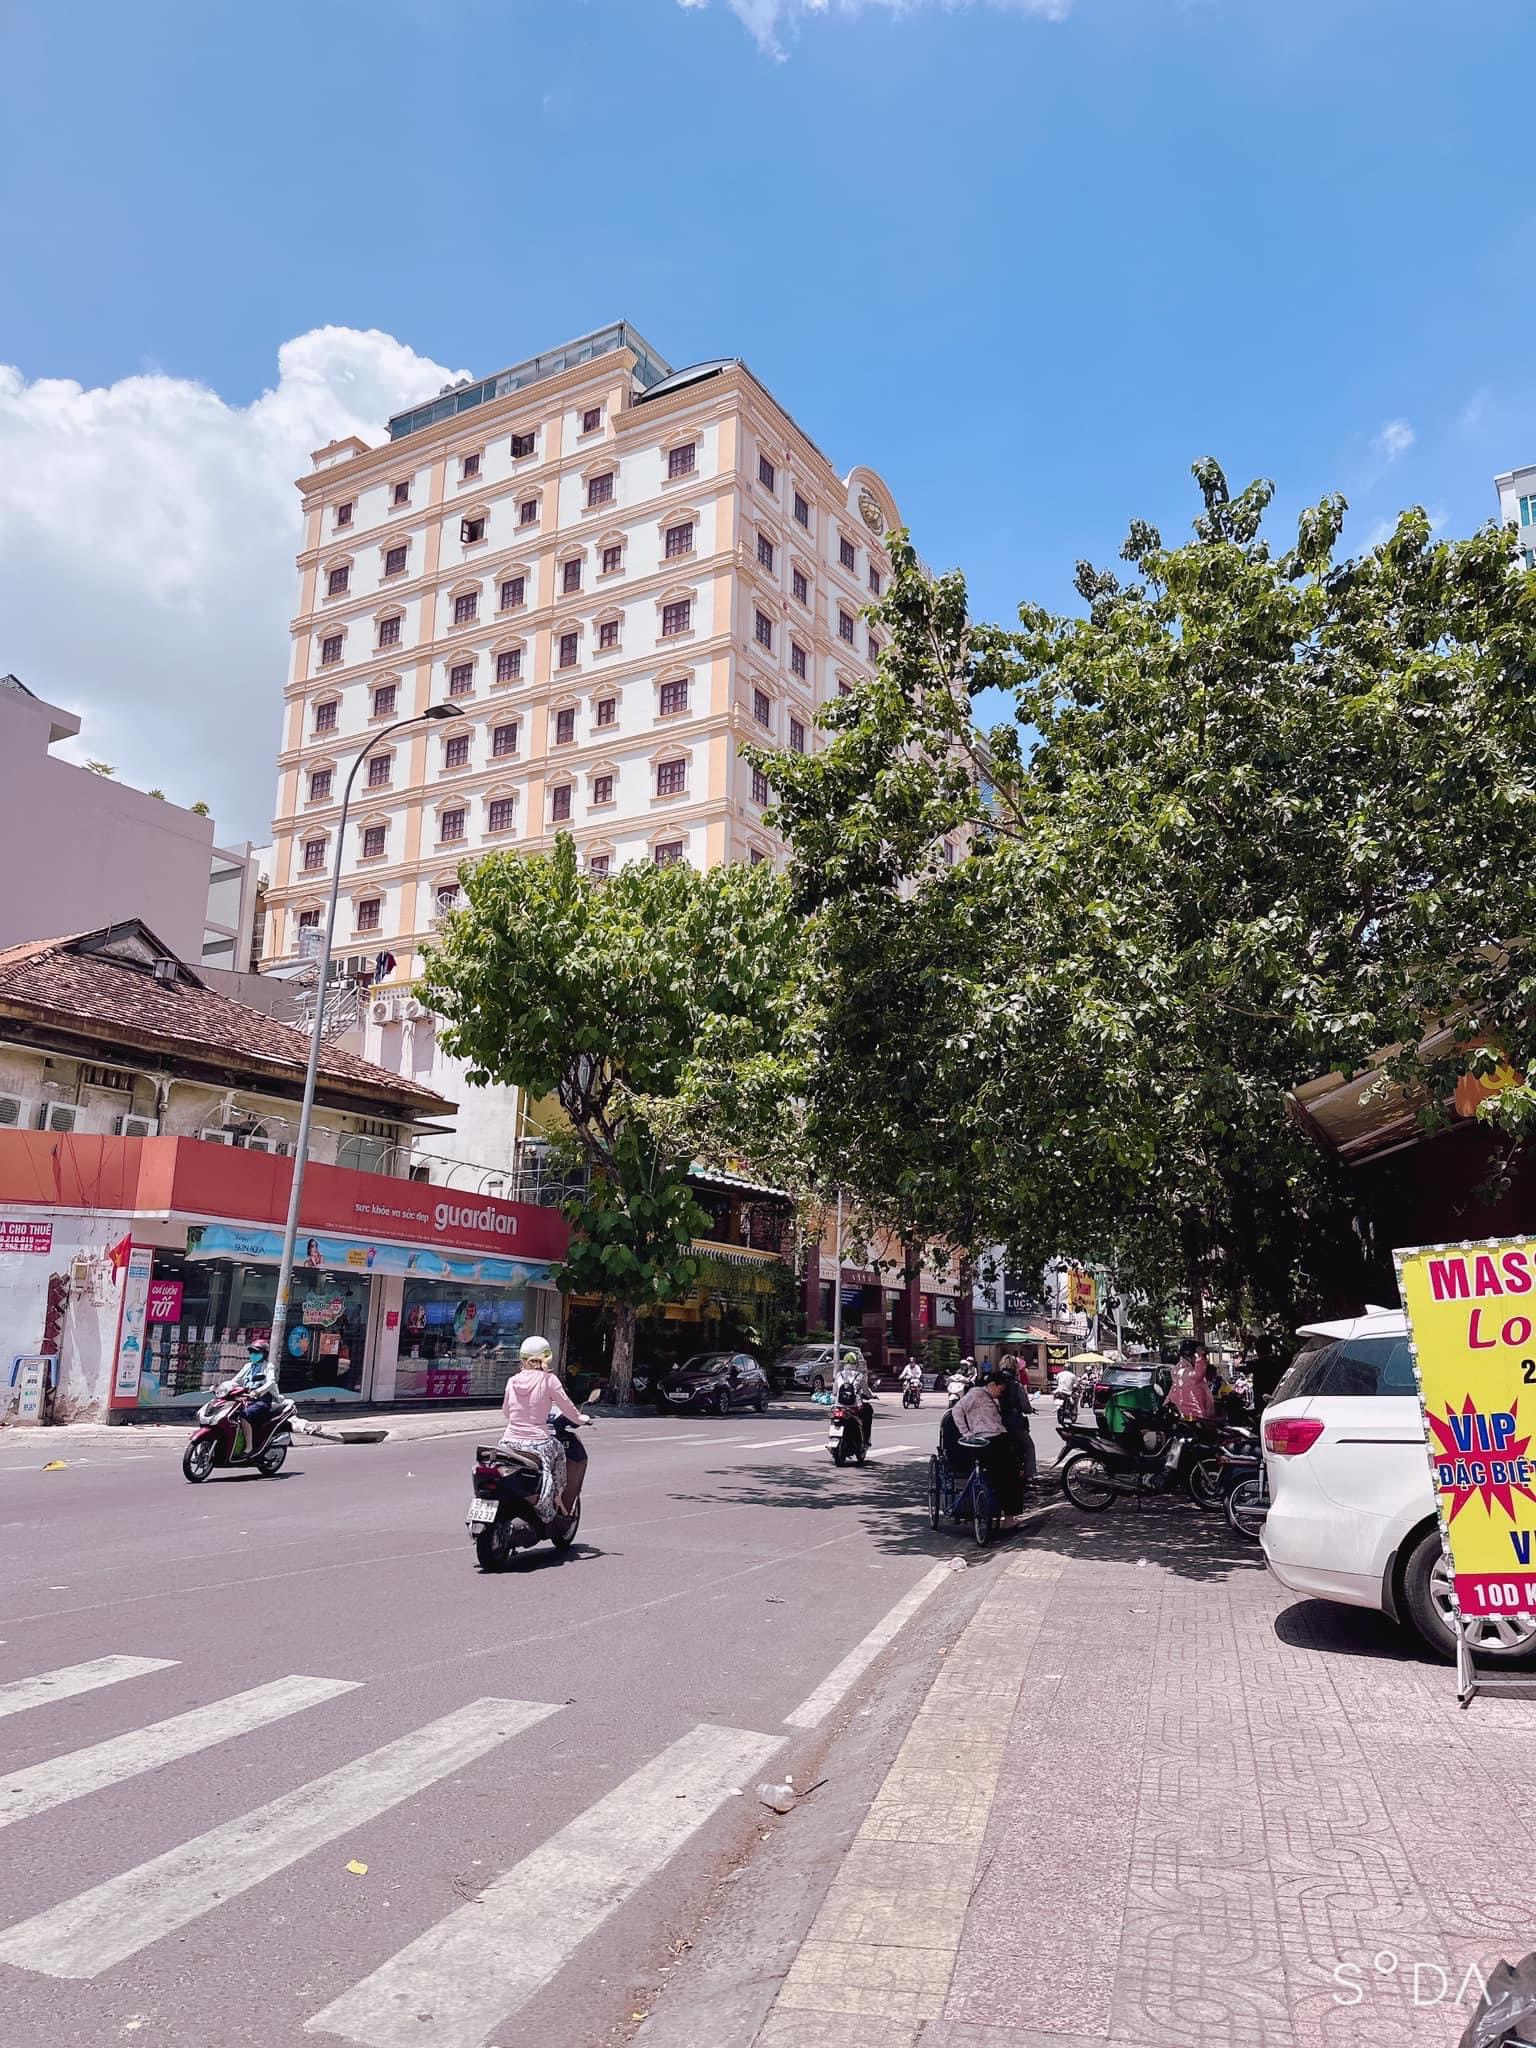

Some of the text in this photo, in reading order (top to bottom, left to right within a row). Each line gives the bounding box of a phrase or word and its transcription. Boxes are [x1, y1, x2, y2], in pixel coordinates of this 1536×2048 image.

[9, 1223, 27, 1235] CHO
[30, 1222, 51, 1235] THUÊ
[434, 1202, 518, 1235] guardian
[1428, 1251, 1536, 1301] MAS
[151, 1295, 175, 1318] TỐT
[1468, 1308, 1536, 1349] Lo
[1448, 1412, 1517, 1453] VIP
[1438, 1457, 1487, 1491] ĐẶC
[1509, 1530, 1536, 1565] V
